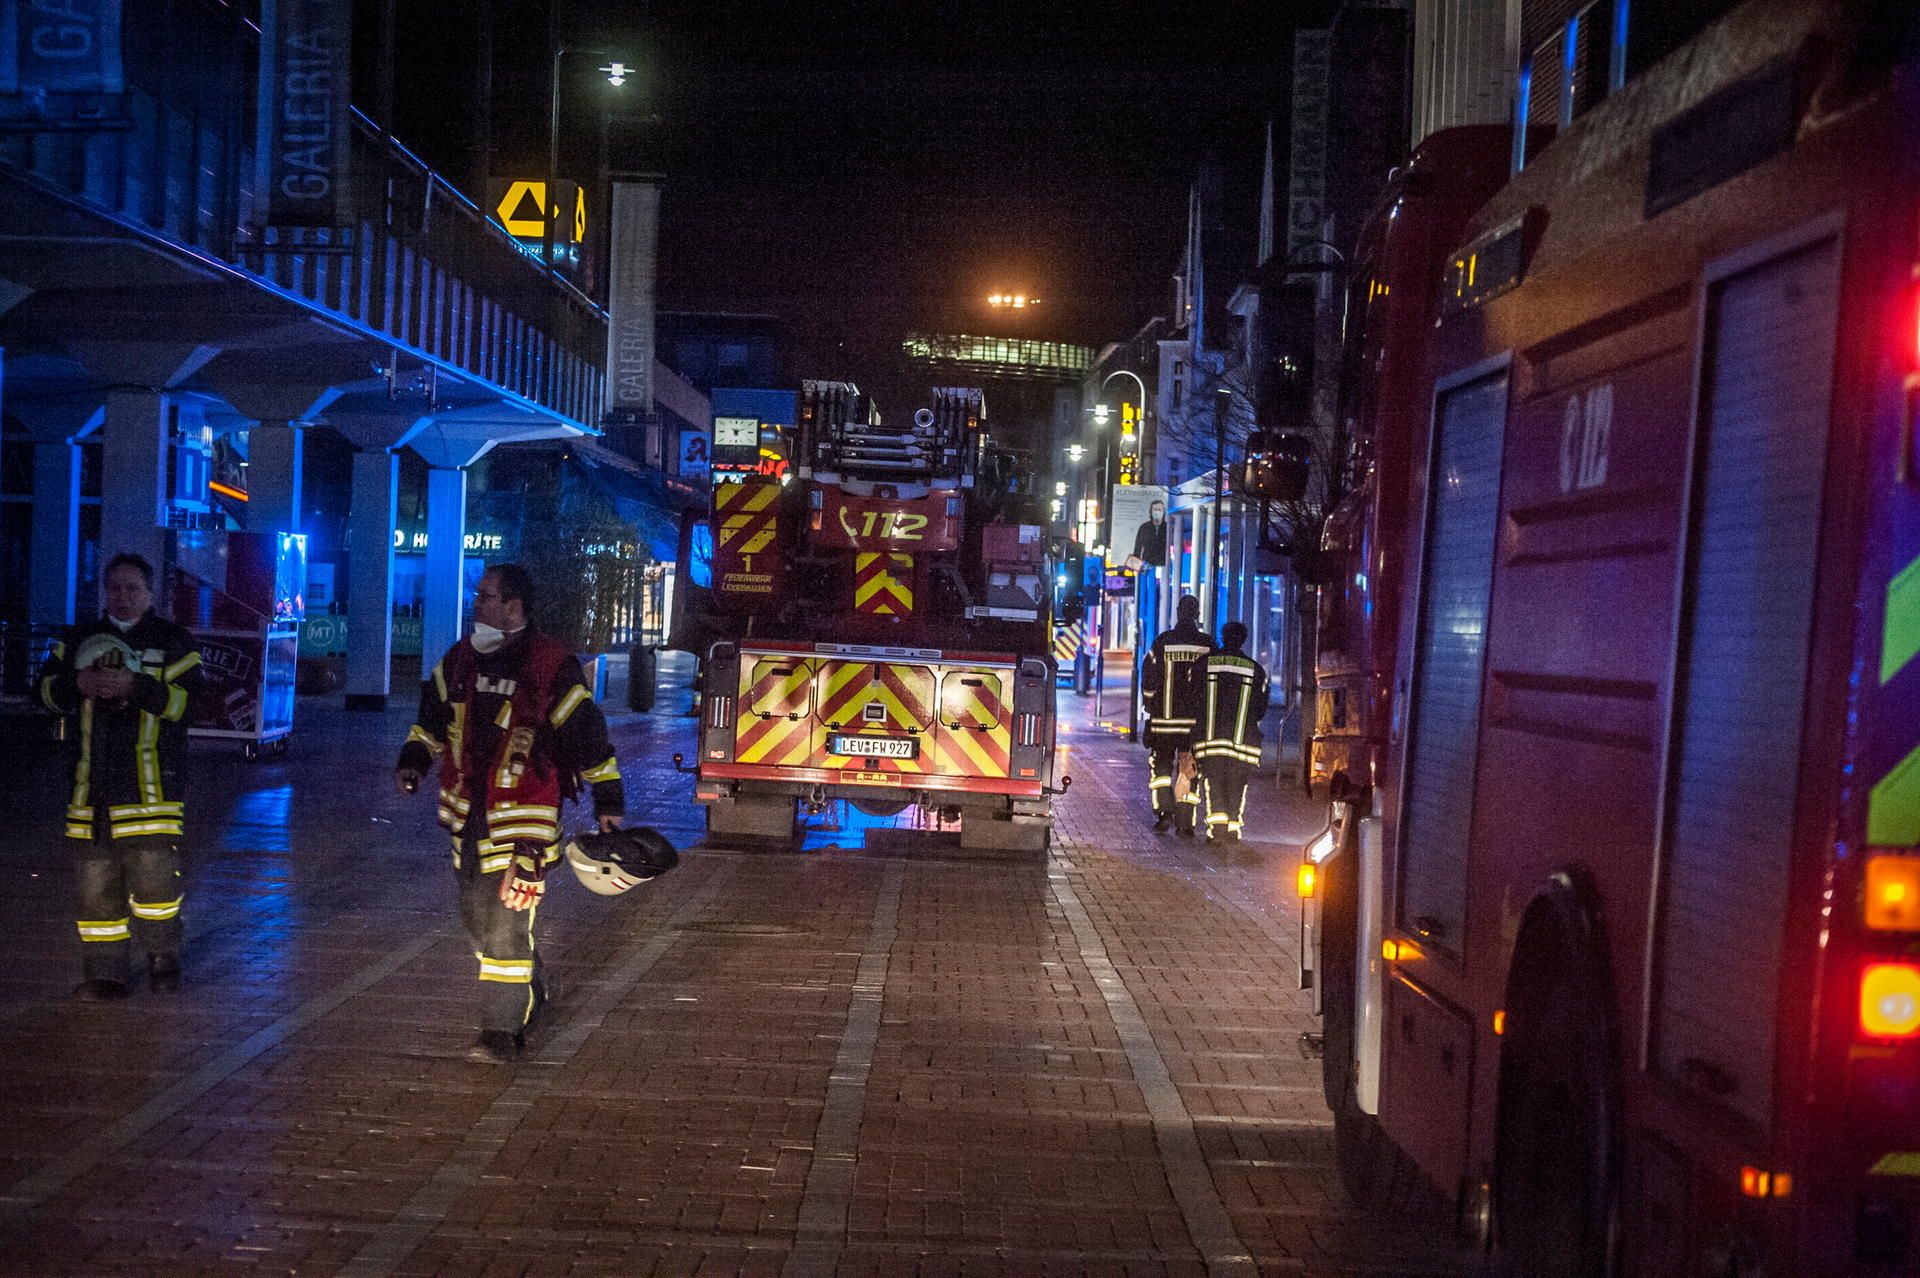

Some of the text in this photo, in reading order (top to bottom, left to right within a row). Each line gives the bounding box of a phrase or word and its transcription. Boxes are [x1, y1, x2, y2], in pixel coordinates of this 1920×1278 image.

[281, 27, 331, 199] GALERIA
[619, 317, 645, 401] GALERIA
[861, 511, 928, 540] 112
[413, 532, 502, 550] HRÄTE
[742, 554, 752, 572] 1
[310, 626, 332, 639] MT
[1166, 651, 1205, 661] FEUERWE
[842, 739, 910, 756] LEV FW 927
